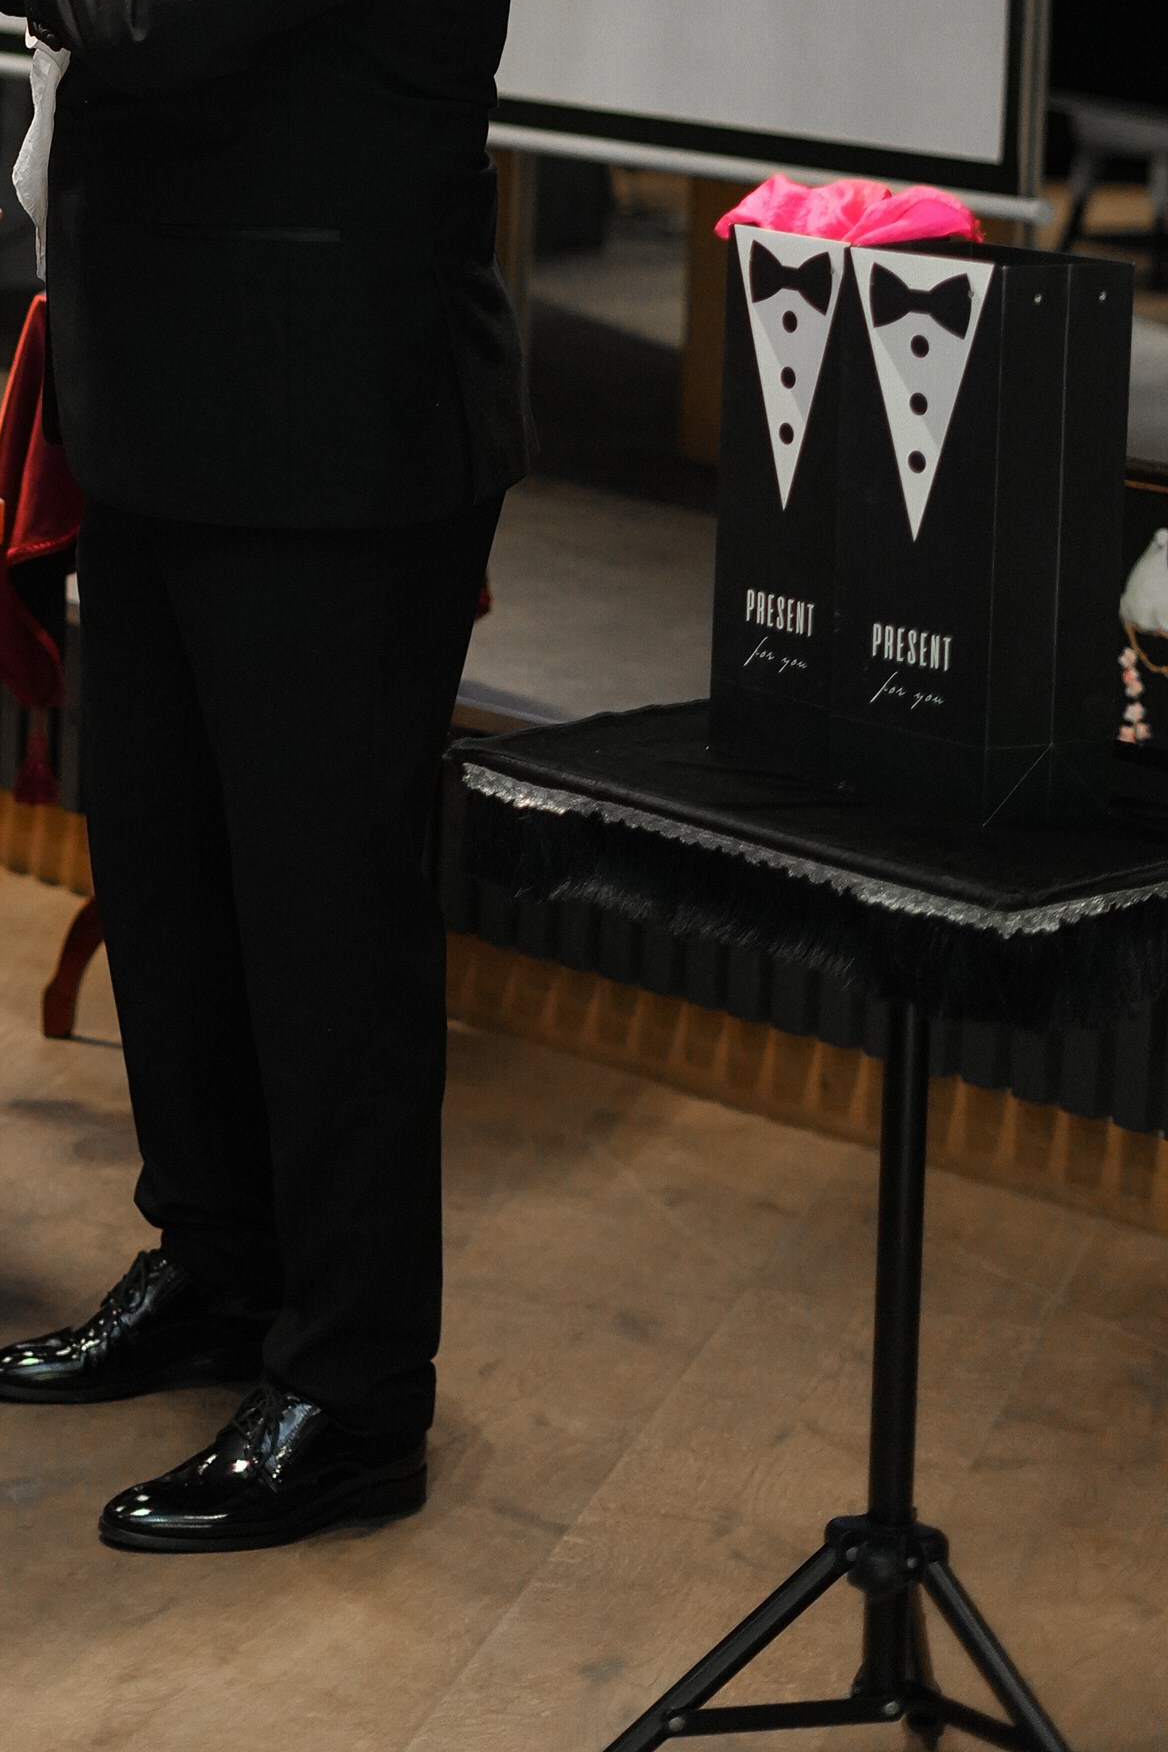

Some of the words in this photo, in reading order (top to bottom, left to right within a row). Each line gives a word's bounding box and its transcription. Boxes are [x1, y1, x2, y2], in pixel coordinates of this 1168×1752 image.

[745, 588, 815, 637] PRESENT
[743, 636, 775, 667] for
[778, 657, 808, 673] you
[872, 622, 952, 672] PRESENT
[870, 671, 906, 703] for
[911, 693, 945, 709] you
